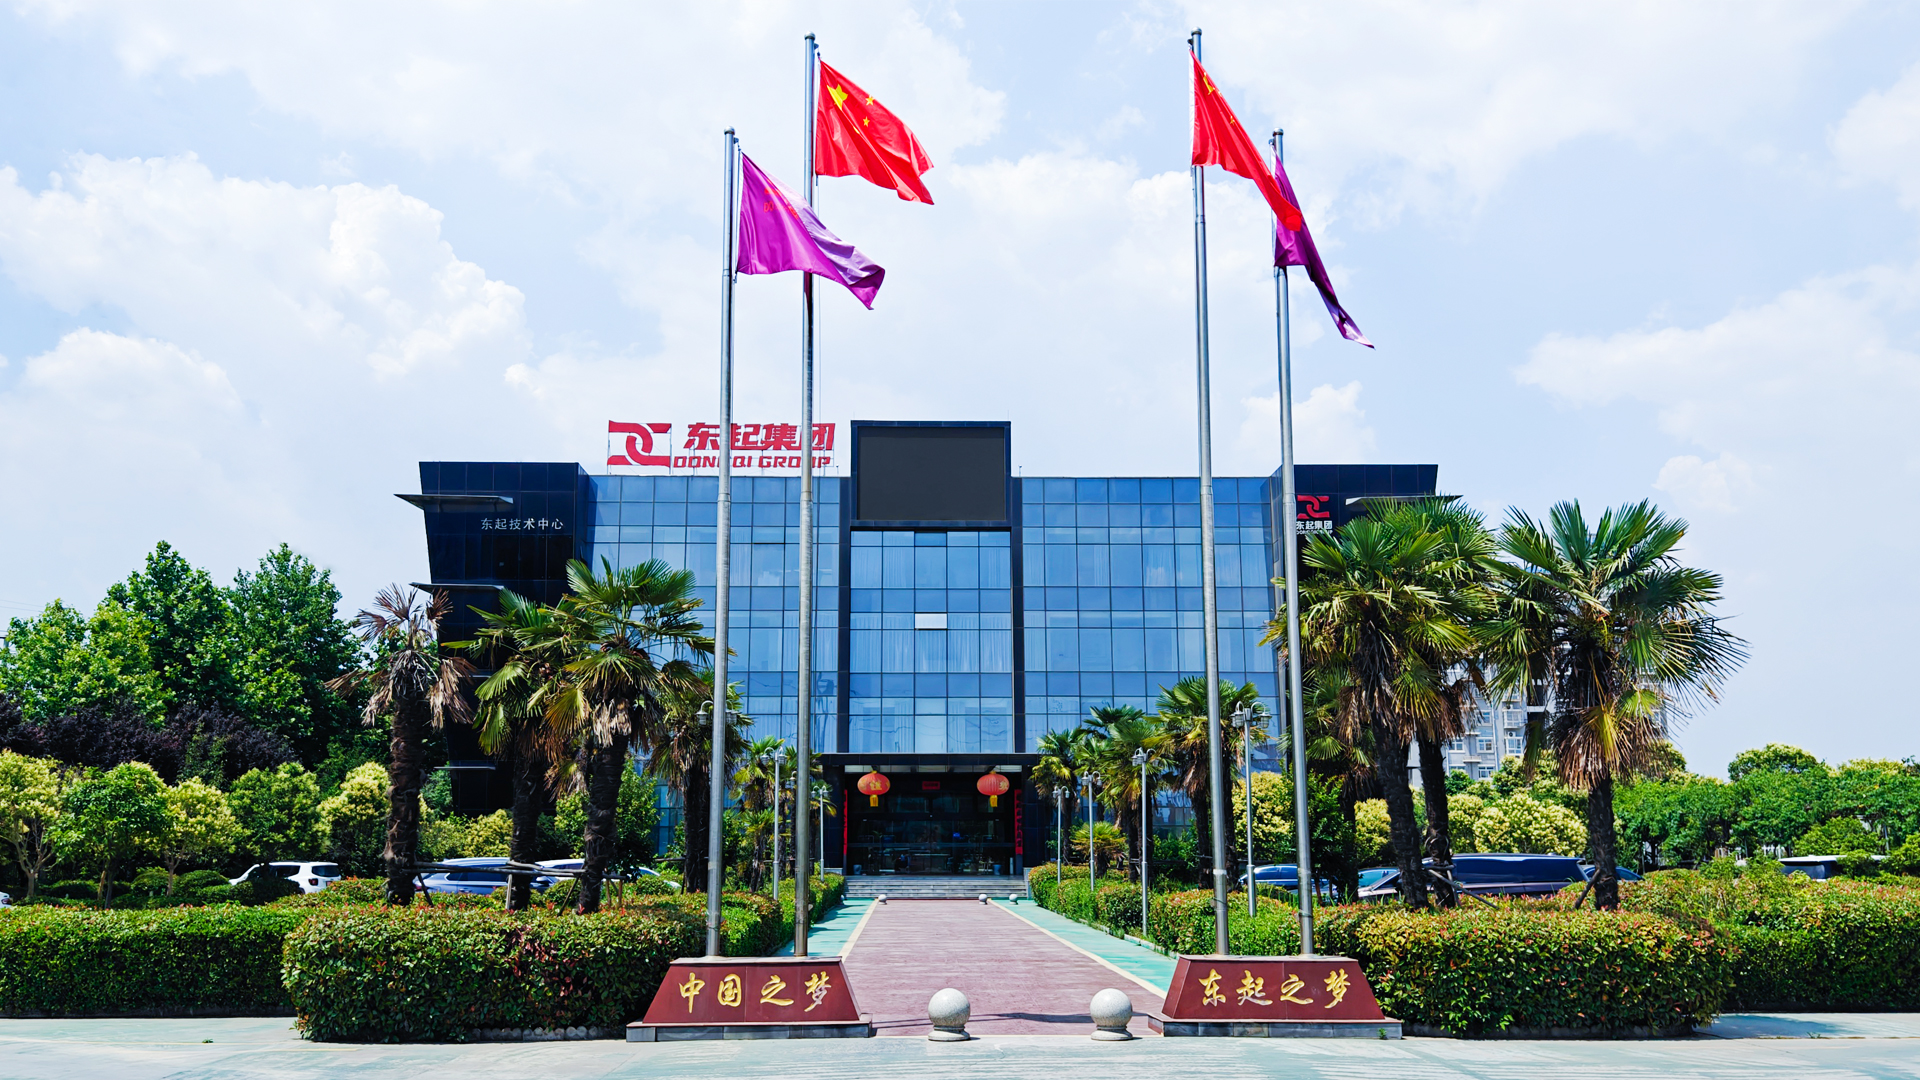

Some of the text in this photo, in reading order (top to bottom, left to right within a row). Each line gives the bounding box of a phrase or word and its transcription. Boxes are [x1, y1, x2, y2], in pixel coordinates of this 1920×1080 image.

[683, 422, 836, 451] 东起集团
[673, 455, 753, 469] DONQI
[480, 517, 564, 531] 东起技术中心
[678, 971, 832, 1014] 中国之梦
[1198, 967, 1351, 1009] 东起之梦
